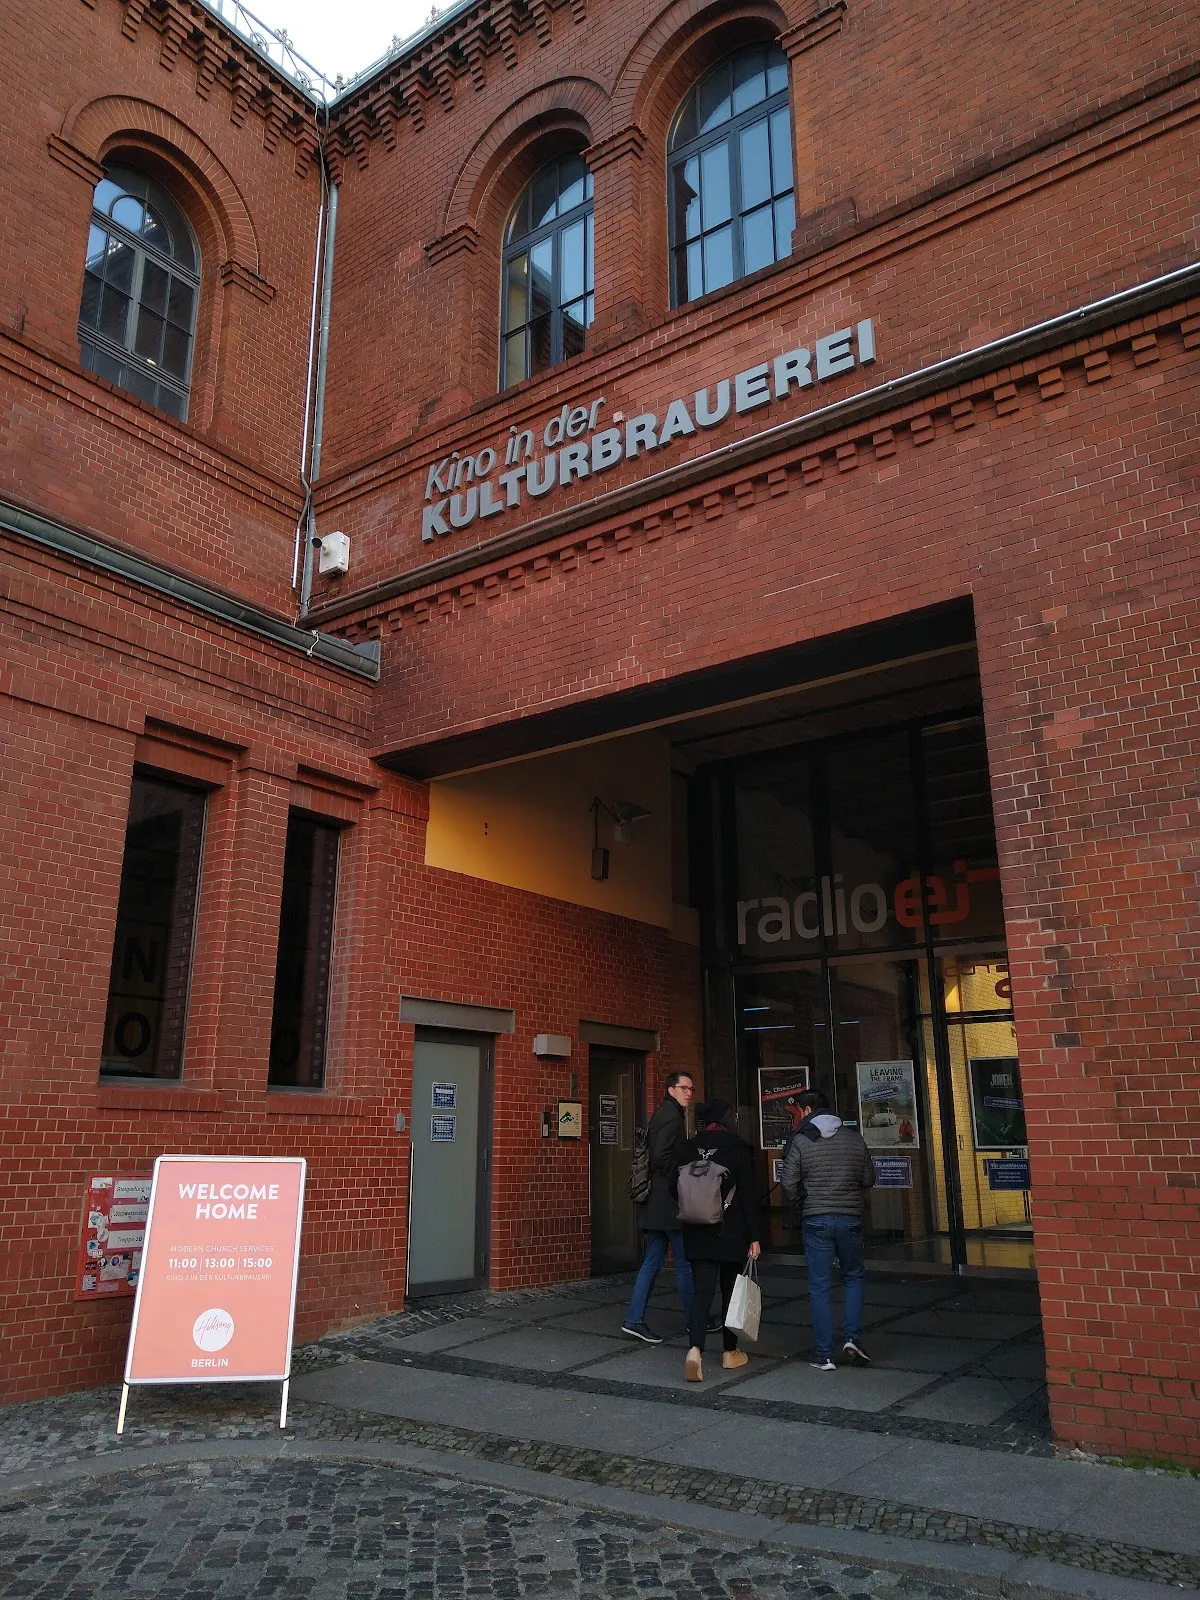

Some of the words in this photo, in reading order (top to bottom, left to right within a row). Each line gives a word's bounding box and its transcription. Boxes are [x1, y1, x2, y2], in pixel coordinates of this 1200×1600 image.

[421, 318, 877, 543] KULTURBRAUEREI
[423, 448, 497, 500] Kino
[504, 425, 534, 464] in
[542, 397, 606, 446] der
[736, 873, 888, 946] radio
[869, 1068, 904, 1077] LEAVING
[178, 1183, 280, 1200] WELCOME
[195, 1203, 259, 1220] HOME
[168, 1257, 197, 1269] 11:00
[204, 1257, 235, 1269] 13:00
[242, 1257, 273, 1268] 15:00
[195, 1315, 232, 1344] Hillsong
[191, 1358, 229, 1368] BERLIN
